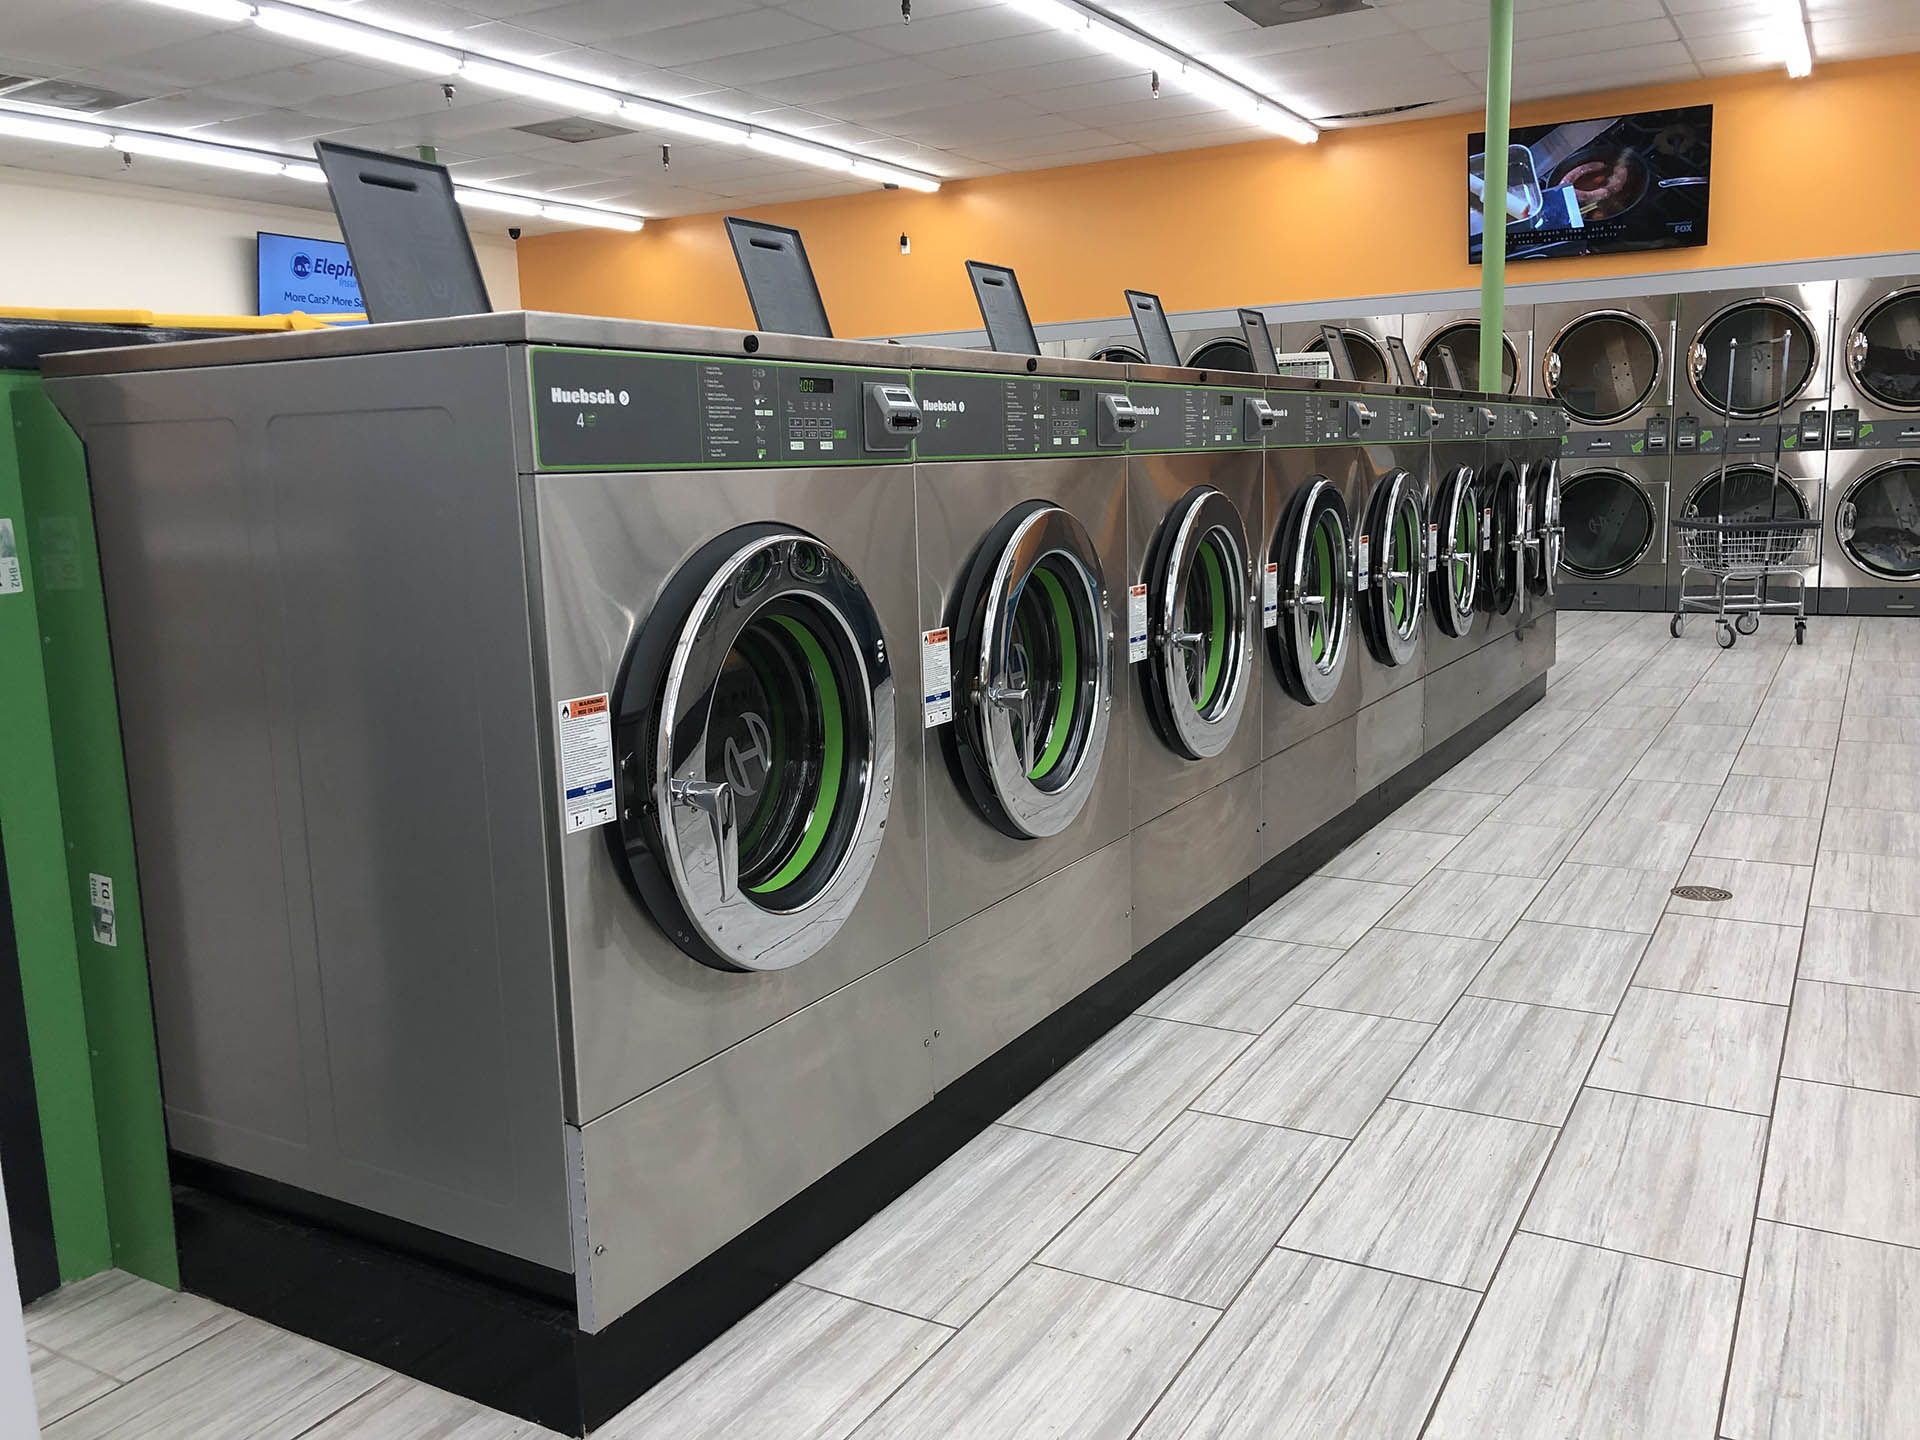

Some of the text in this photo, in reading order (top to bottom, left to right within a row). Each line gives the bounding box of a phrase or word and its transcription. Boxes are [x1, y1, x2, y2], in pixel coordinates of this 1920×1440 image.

[1674, 224, 1692, 233] FOX
[314, 258, 356, 280] Eleph
[284, 291, 306, 303] More
[308, 293, 330, 305] Cars?
[332, 296, 352, 307] More
[551, 387, 615, 404] Huebsch
[923, 400, 957, 411] Huebsch
[576, 412, 585, 428] 4
[935, 418, 941, 428] 4
